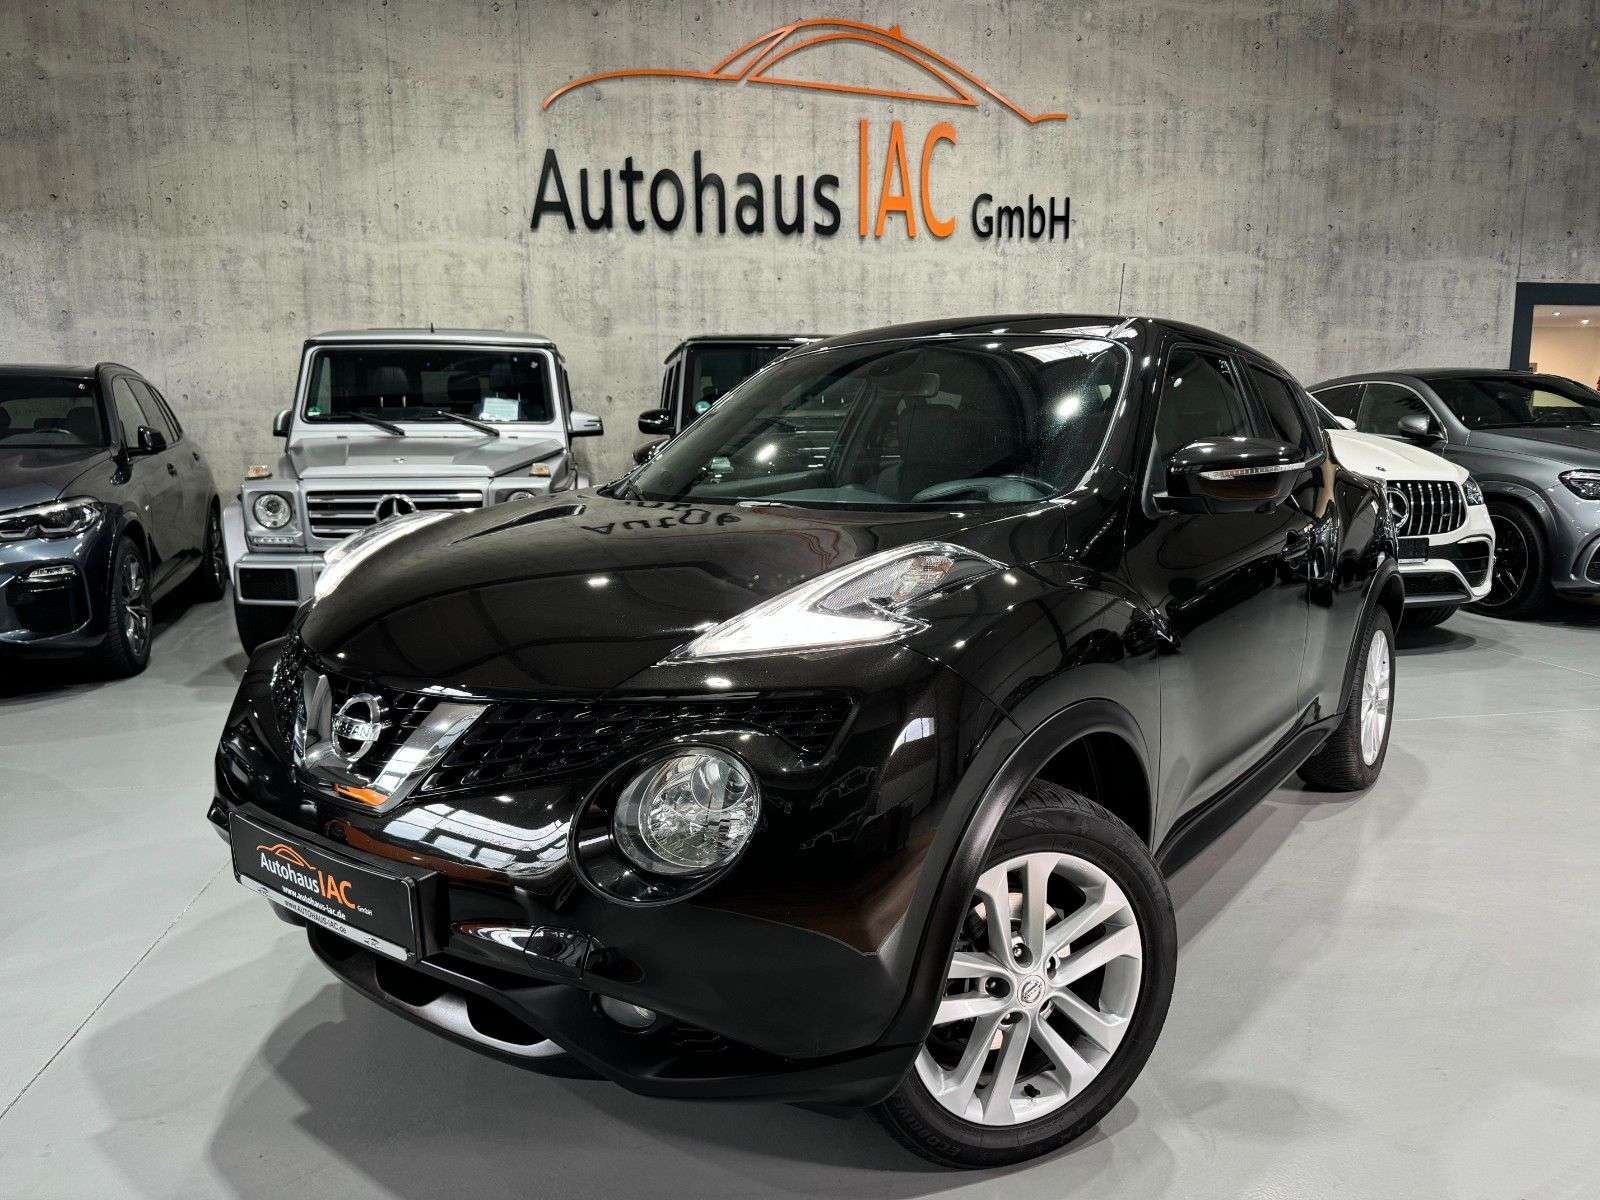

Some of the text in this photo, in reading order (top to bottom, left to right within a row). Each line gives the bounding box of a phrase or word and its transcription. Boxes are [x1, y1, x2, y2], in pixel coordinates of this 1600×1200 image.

[530, 118, 1072, 241] Autohaus IAC GmbH
[260, 852, 320, 894] Autohaus
[318, 870, 356, 909] IAC
